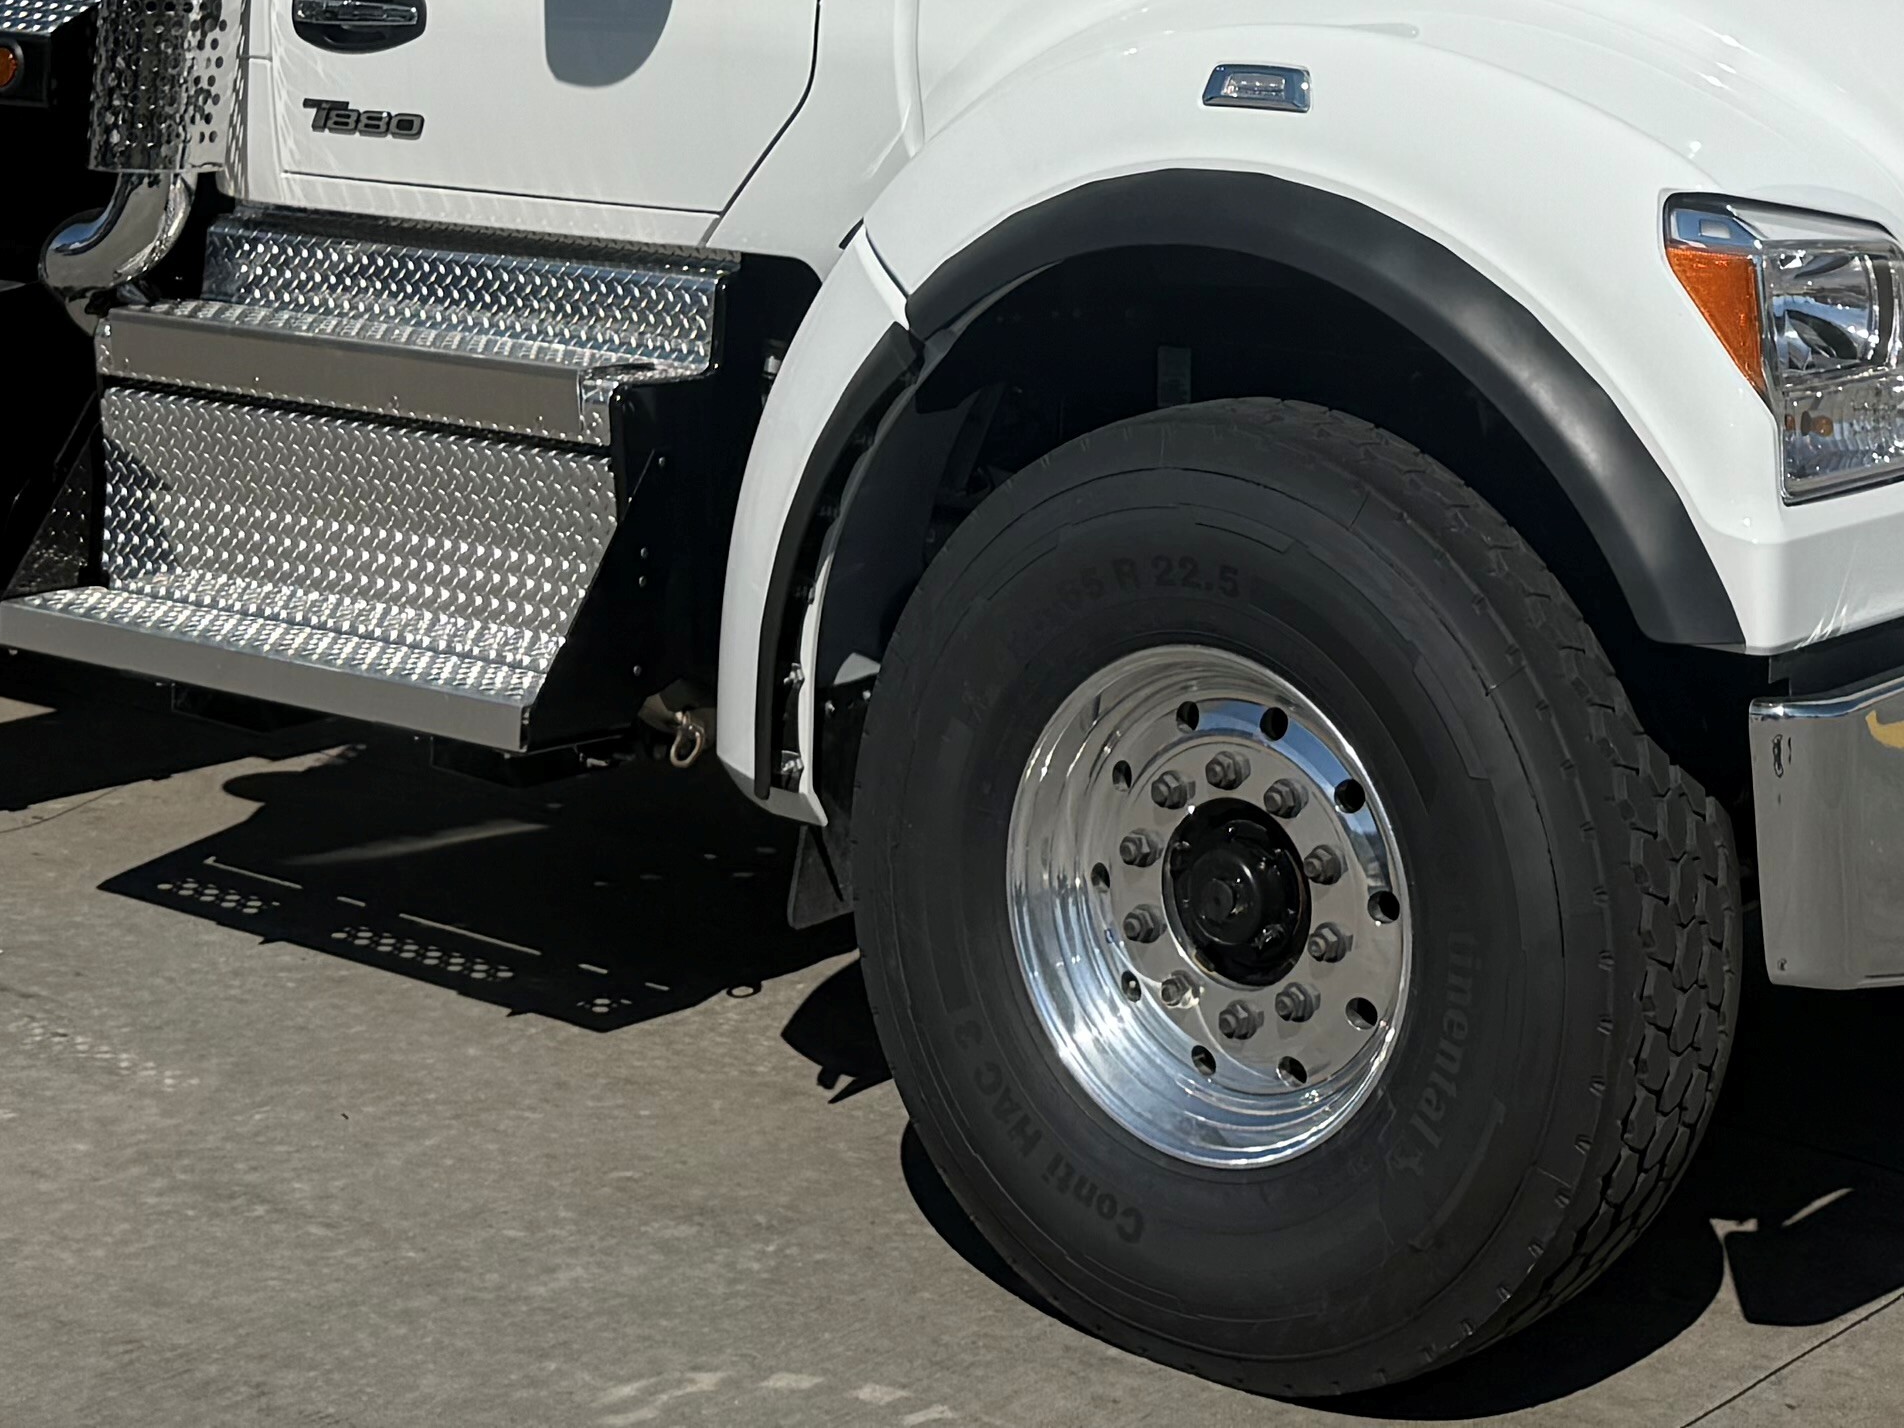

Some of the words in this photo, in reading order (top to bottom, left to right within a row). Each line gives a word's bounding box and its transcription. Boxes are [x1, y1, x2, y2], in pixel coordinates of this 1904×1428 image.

[302, 97, 425, 140] T880
[1149, 553, 1242, 598] 22.5
[973, 1060, 1044, 1159] HAC
[1041, 1152, 1146, 1244] Conti
